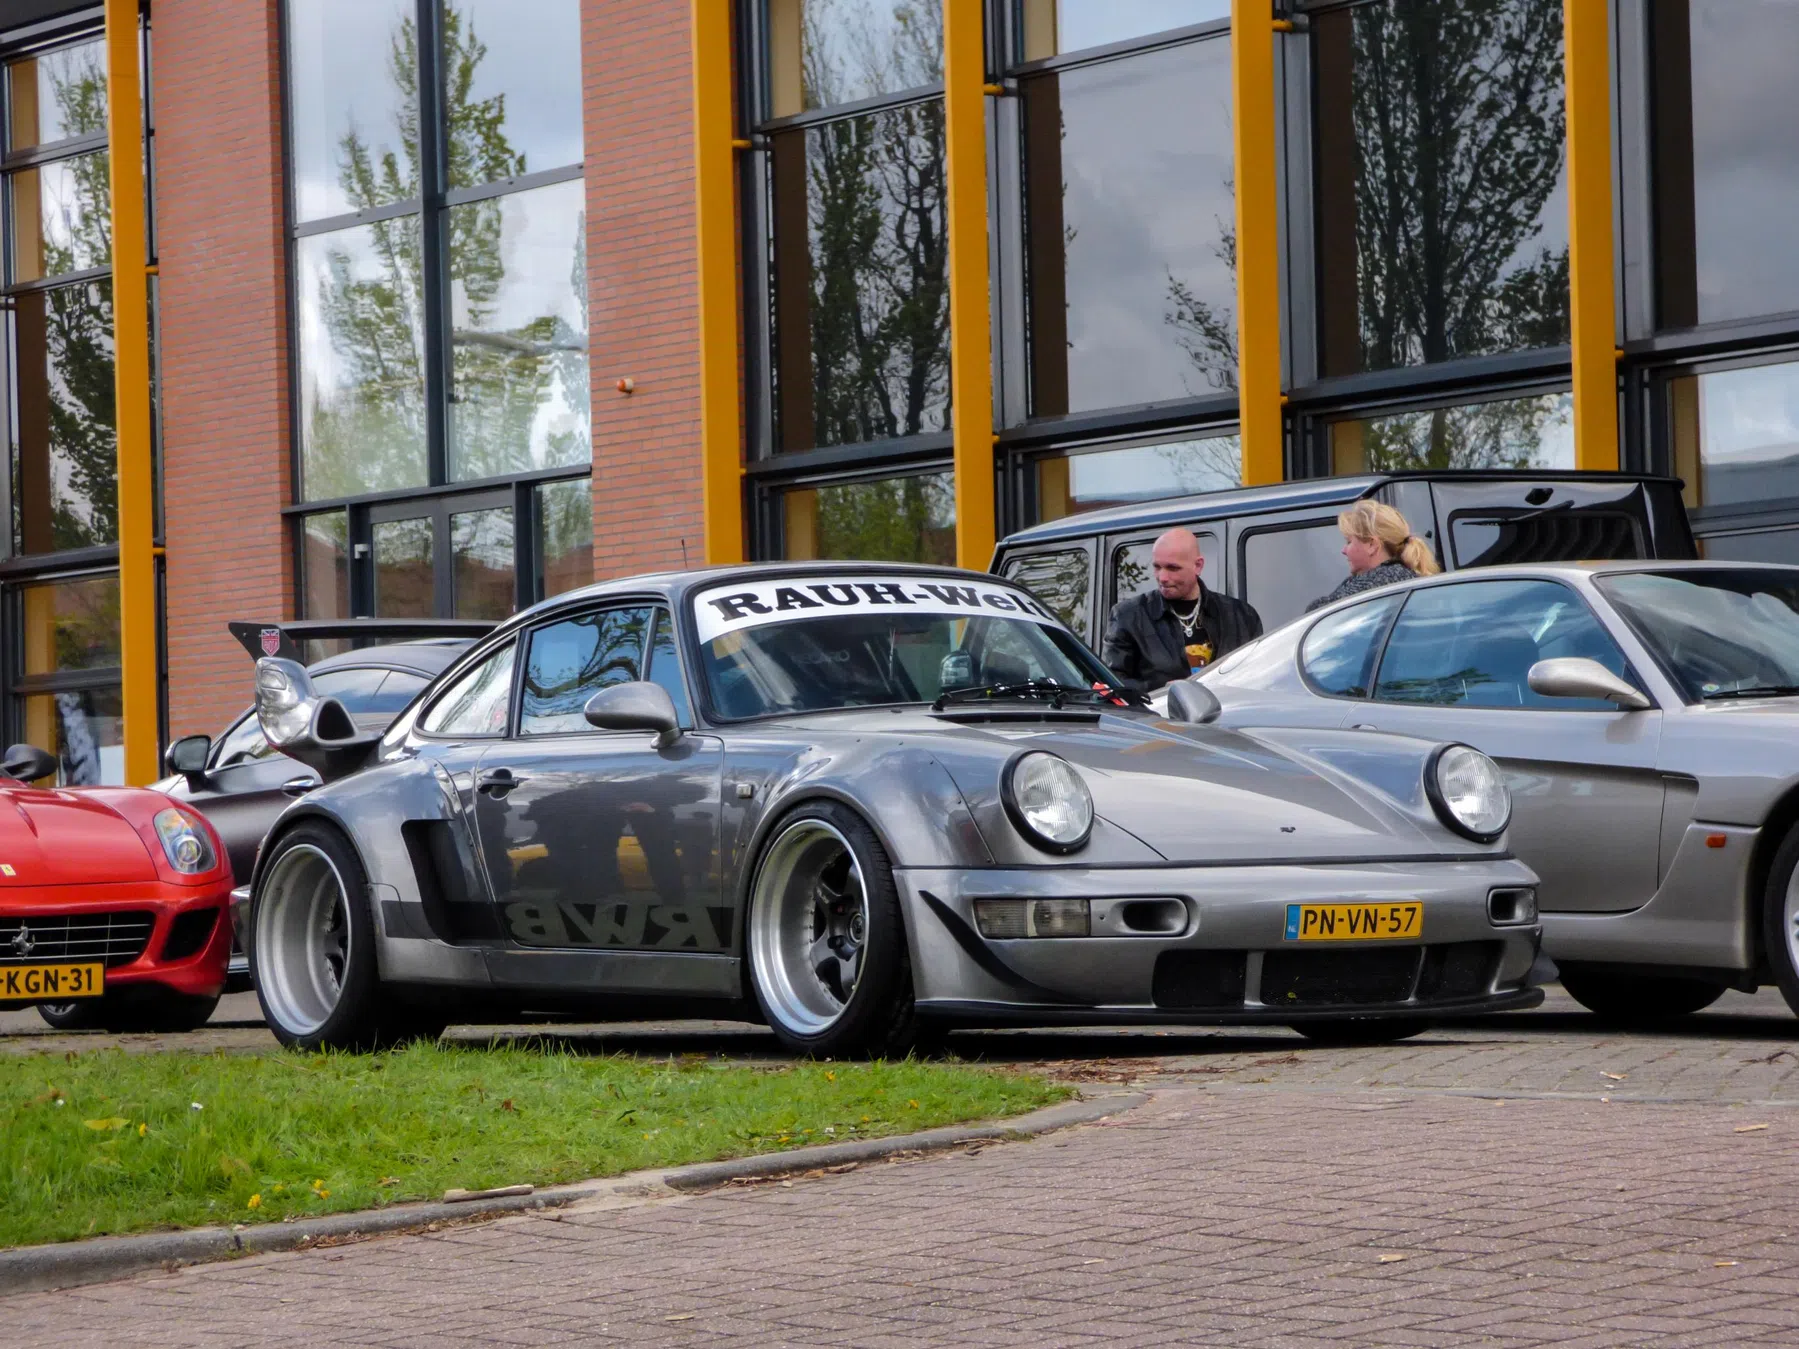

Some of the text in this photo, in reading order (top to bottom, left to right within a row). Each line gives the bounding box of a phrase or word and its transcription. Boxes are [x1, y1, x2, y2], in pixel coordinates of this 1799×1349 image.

[707, 583, 1054, 622] RAUH-Welt
[1287, 907, 1417, 935] NL PN-VN-57
